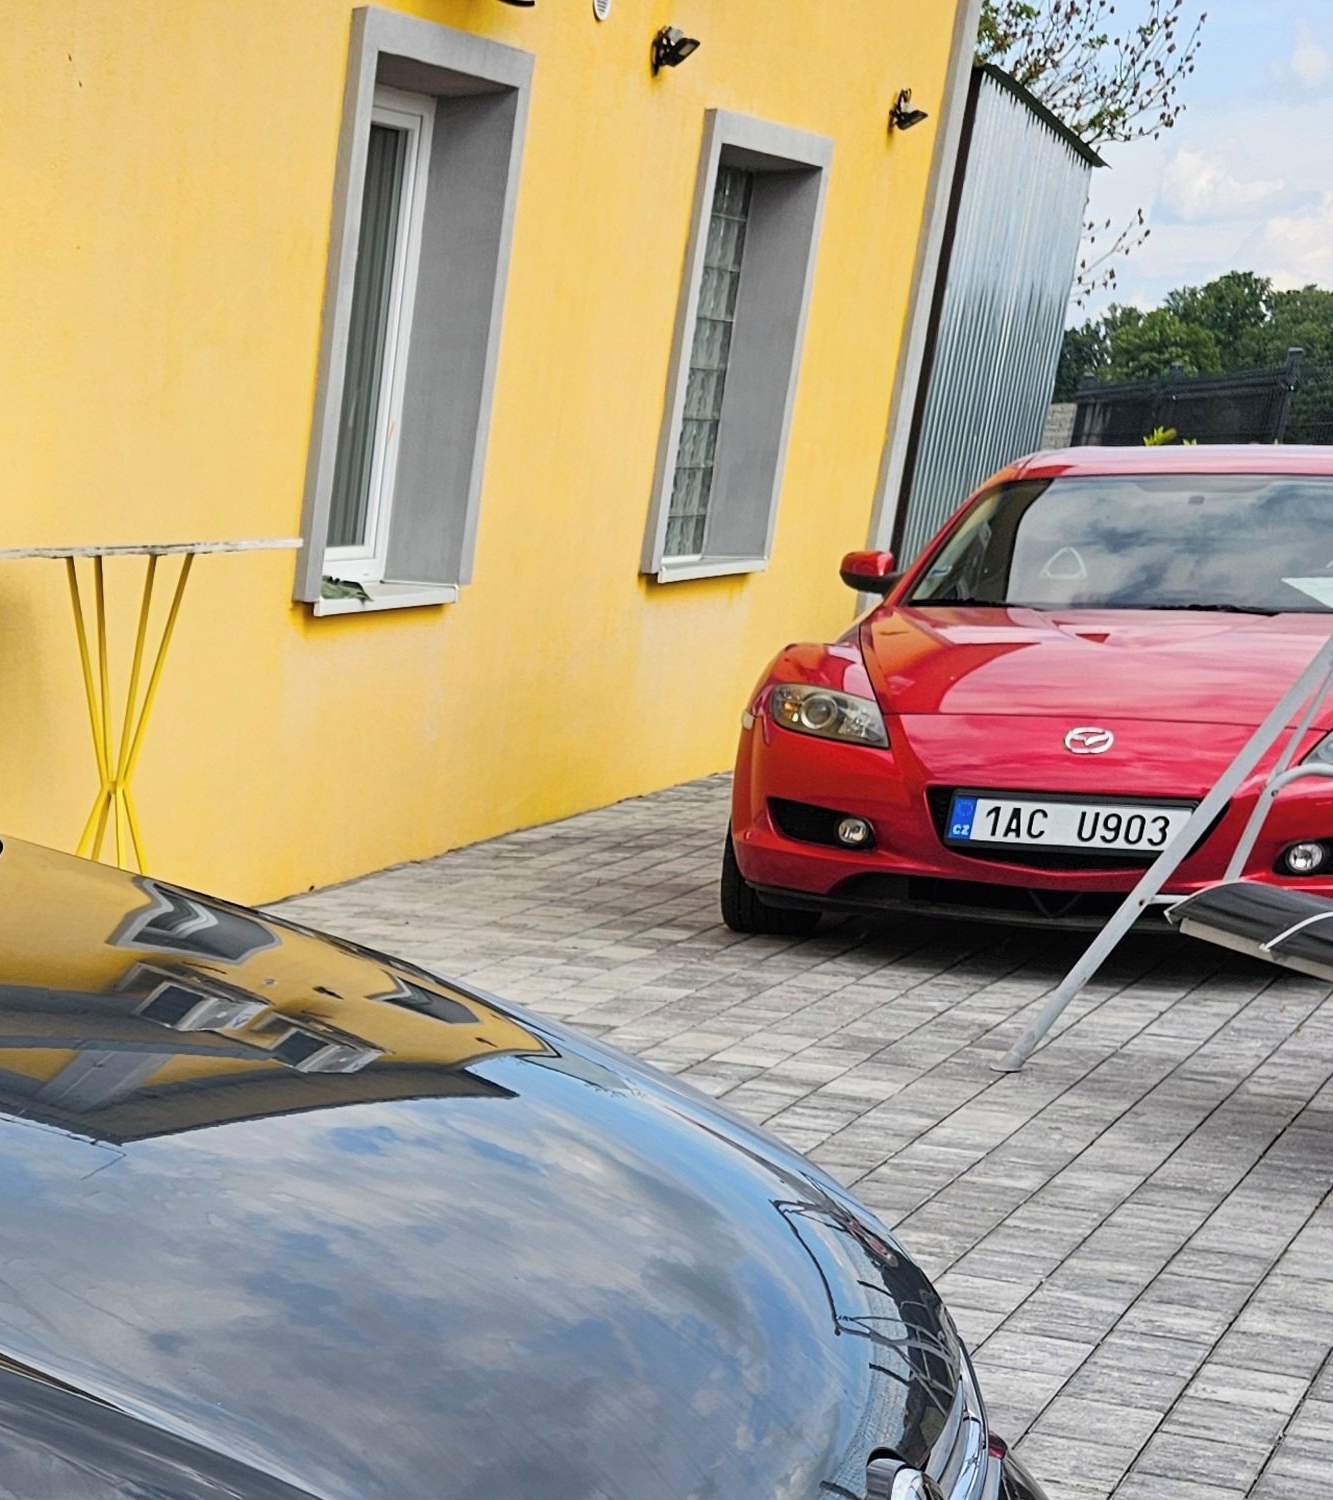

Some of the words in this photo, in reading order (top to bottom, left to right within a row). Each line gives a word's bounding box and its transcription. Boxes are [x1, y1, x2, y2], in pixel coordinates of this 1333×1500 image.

[952, 824, 969, 836] CZ
[985, 806, 1048, 839] 1AC
[1076, 810, 1171, 847] U903
